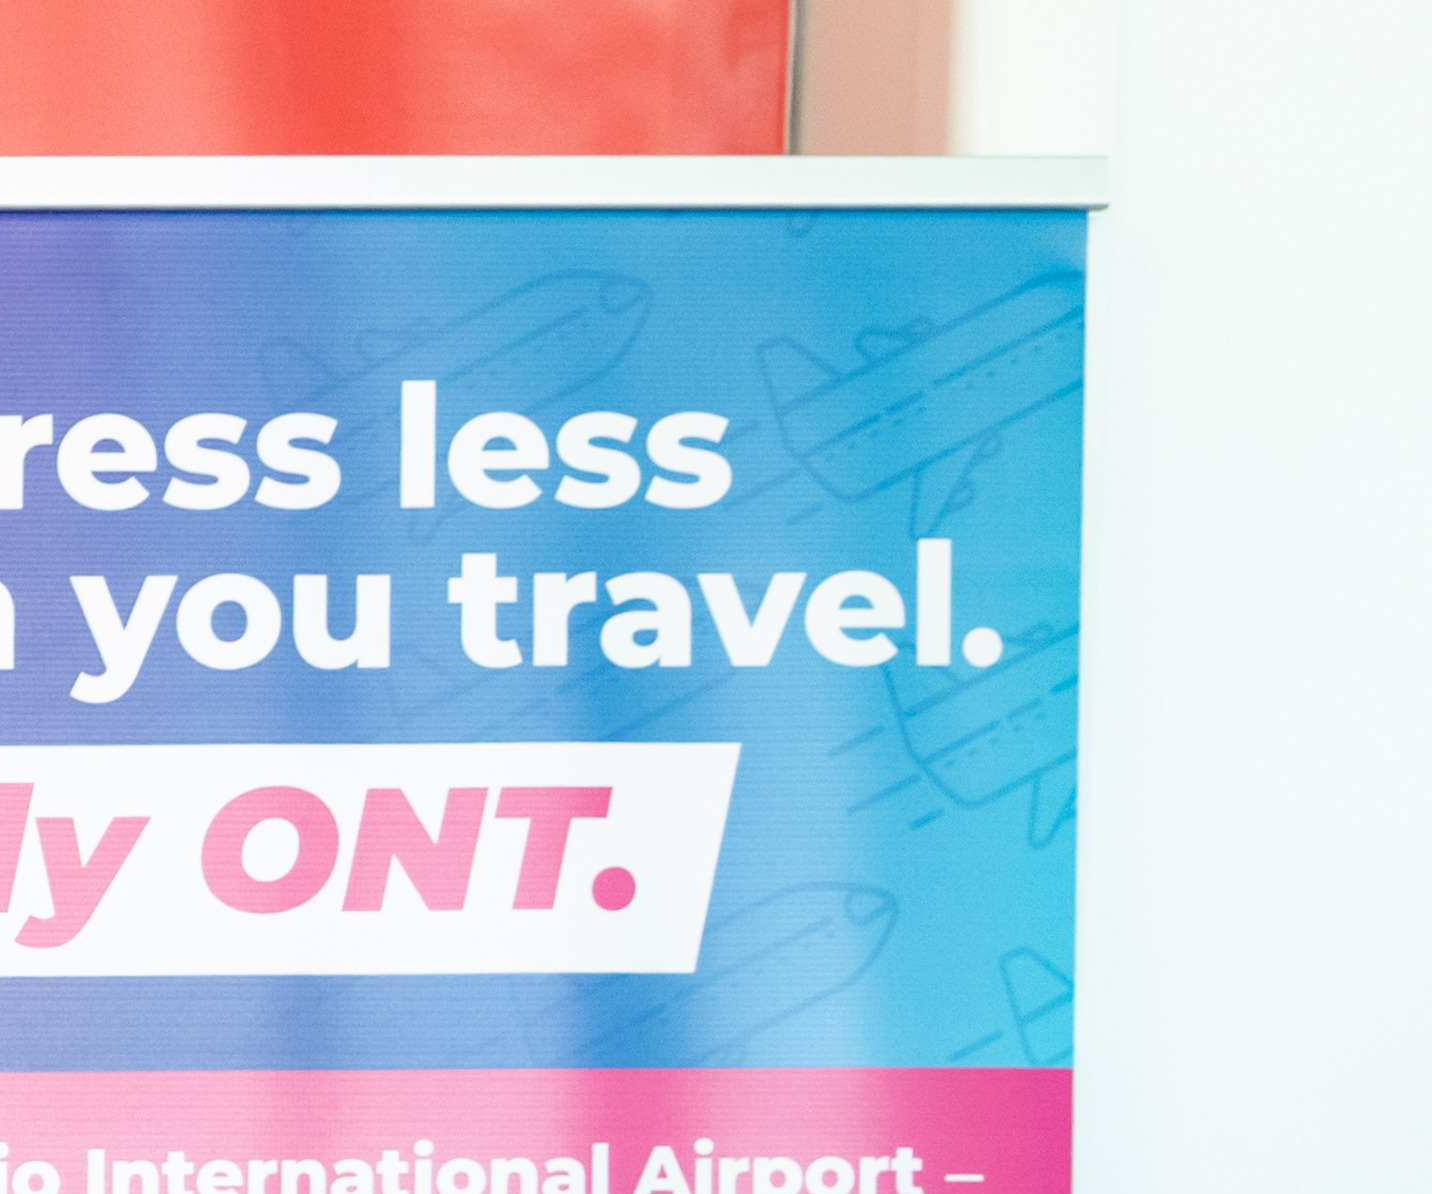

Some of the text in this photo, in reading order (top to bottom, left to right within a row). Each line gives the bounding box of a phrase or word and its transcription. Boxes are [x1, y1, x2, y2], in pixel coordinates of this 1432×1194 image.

[400, 380, 733, 509] less
[70, 573, 391, 703] you
[448, 538, 1004, 669] travel.
[201, 785, 636, 914] ONT.
